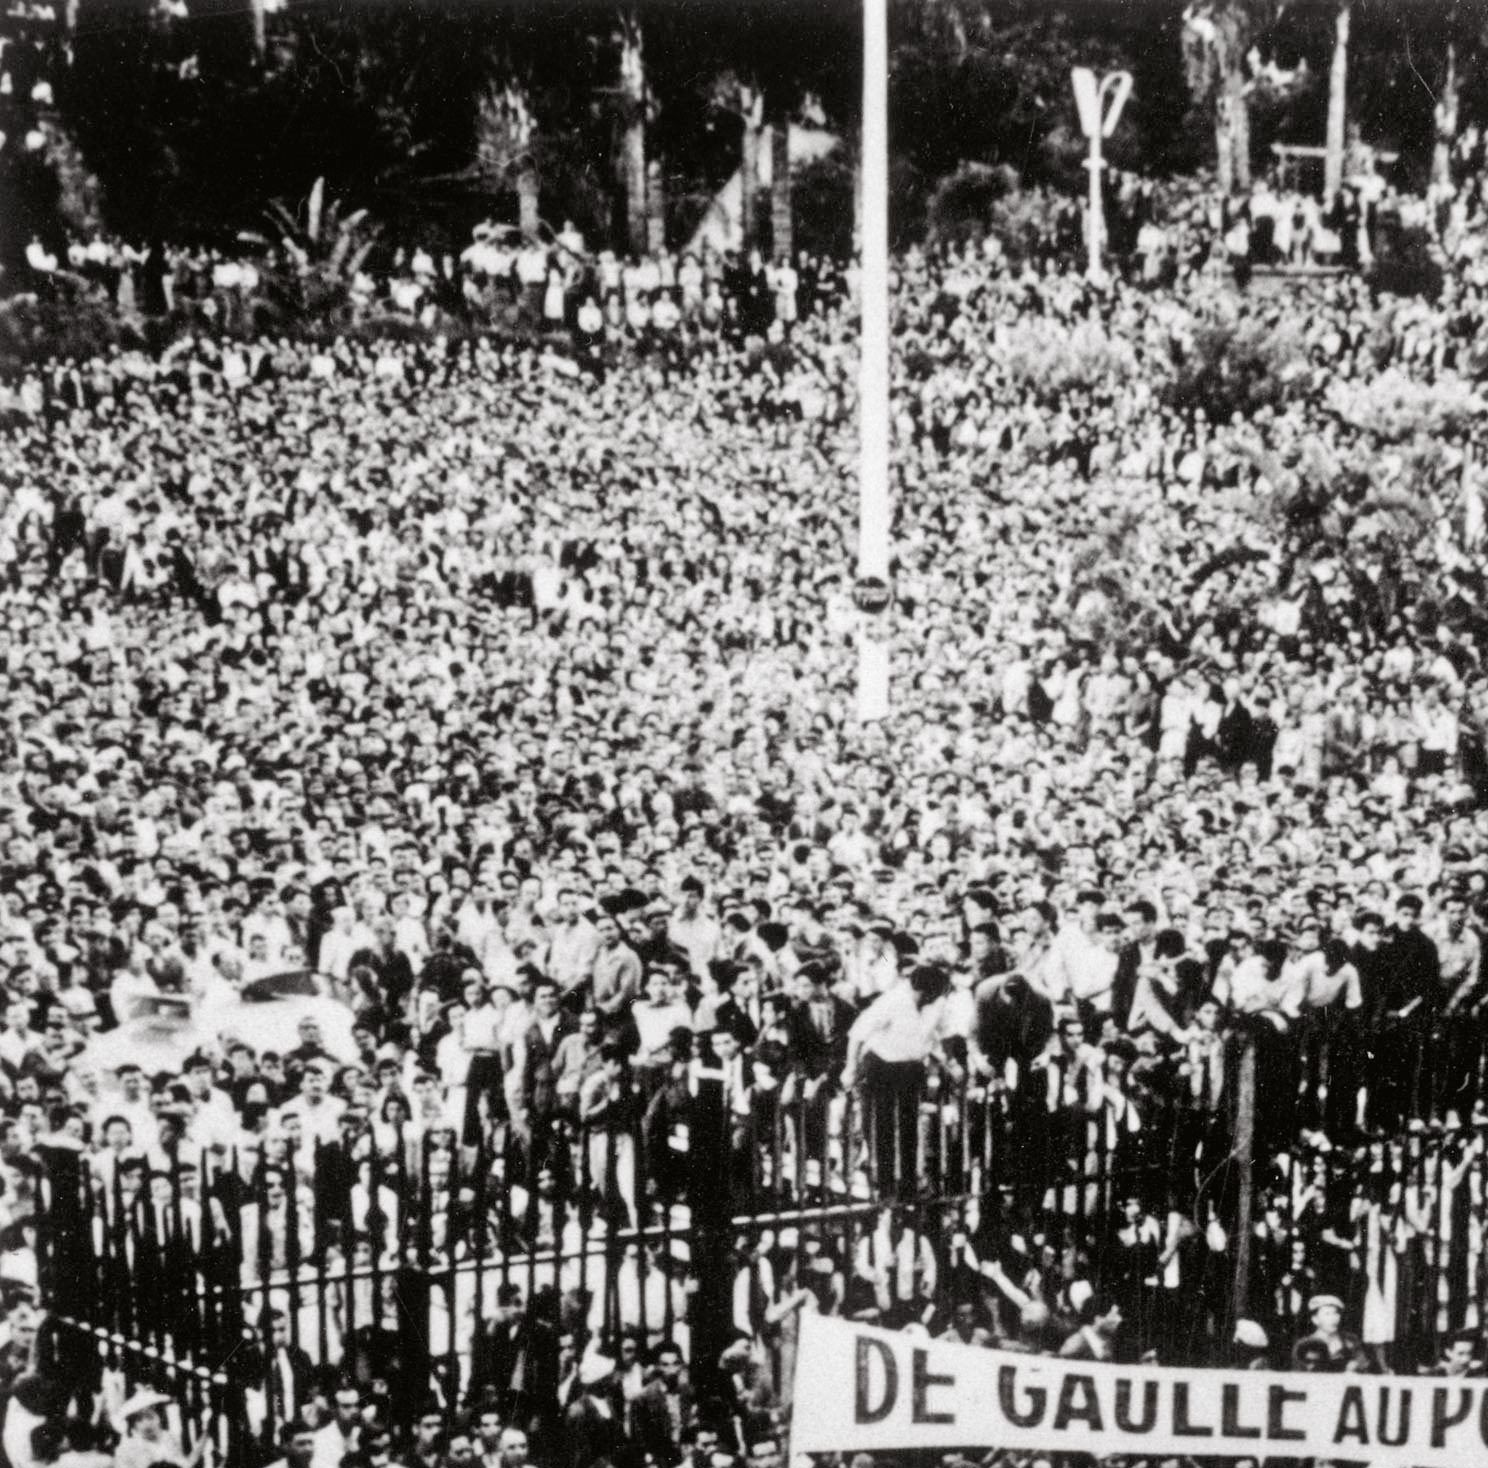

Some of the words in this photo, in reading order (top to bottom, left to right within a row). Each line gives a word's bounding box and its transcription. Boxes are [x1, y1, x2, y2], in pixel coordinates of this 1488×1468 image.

[855, 1335, 955, 1425] DE
[1000, 1364, 1307, 1441] GAULLE
[1333, 1385, 1413, 1446] AU
